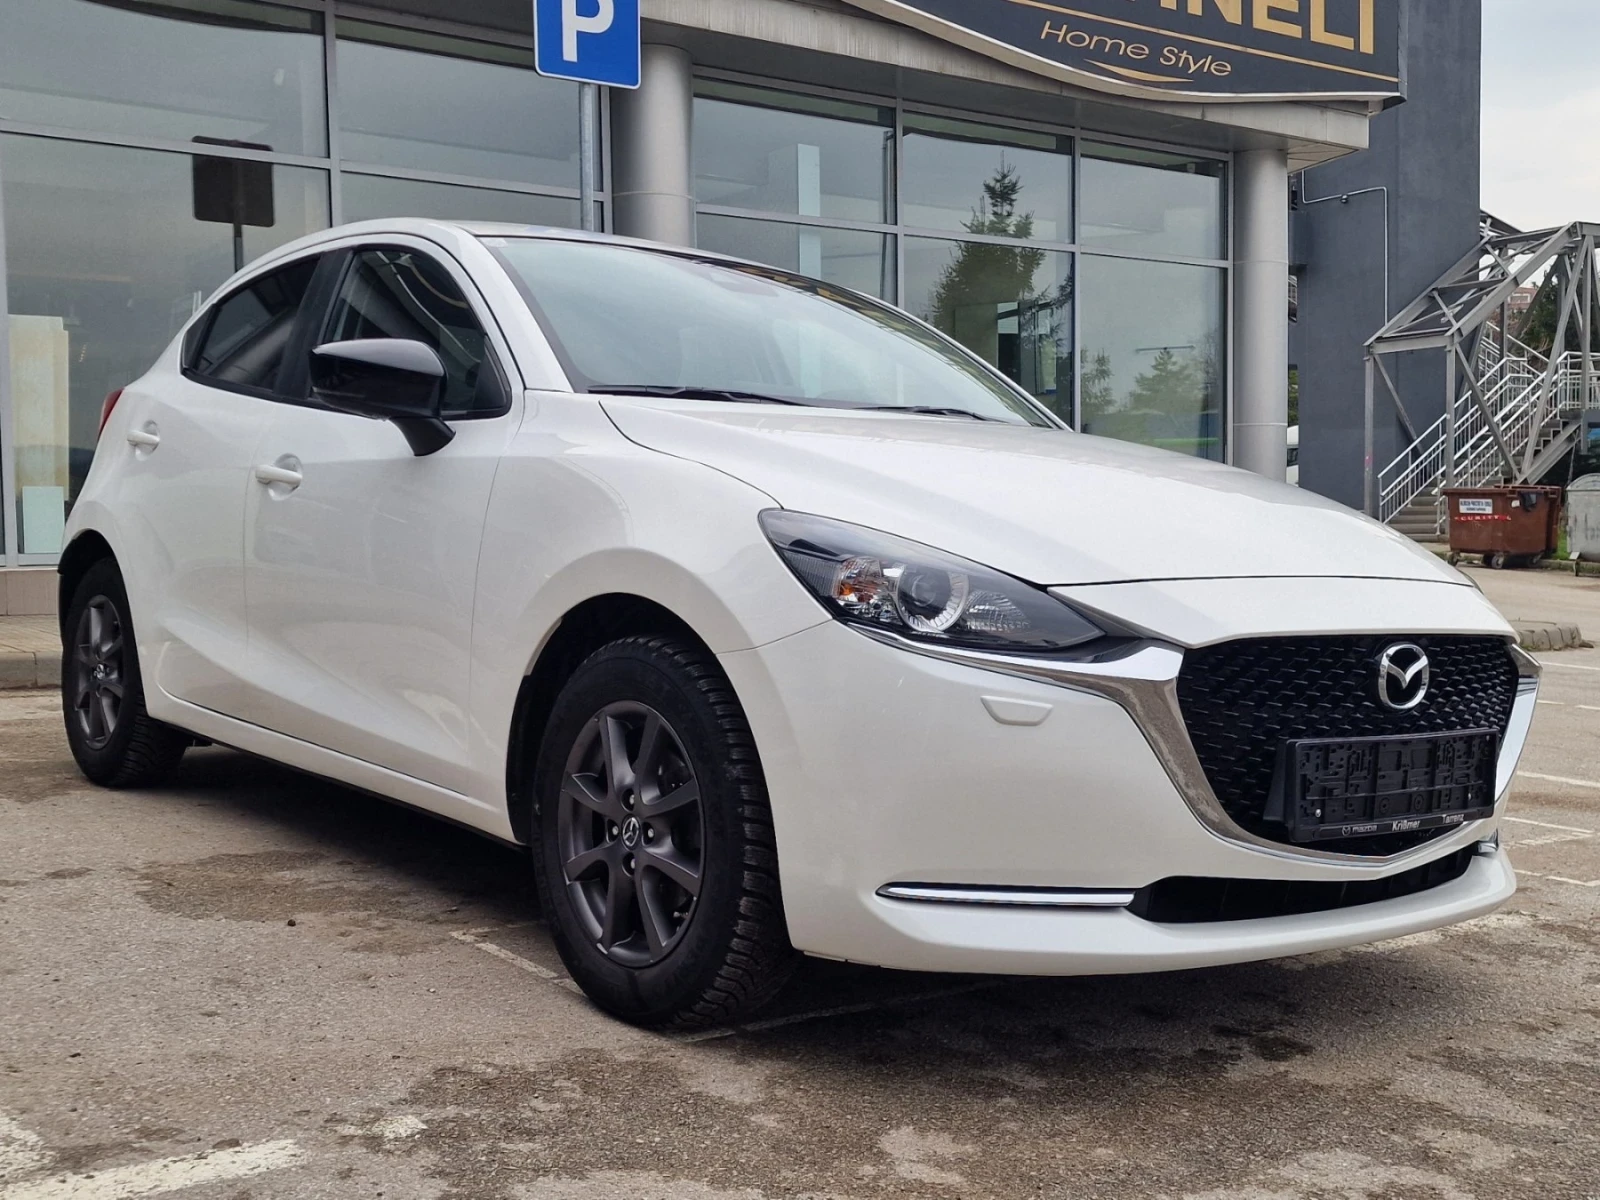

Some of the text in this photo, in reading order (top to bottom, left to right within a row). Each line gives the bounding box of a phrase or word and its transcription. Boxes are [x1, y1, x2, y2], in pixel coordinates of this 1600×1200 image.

[561, 0, 615, 63] P
[1040, 20, 1232, 77] Home Style
